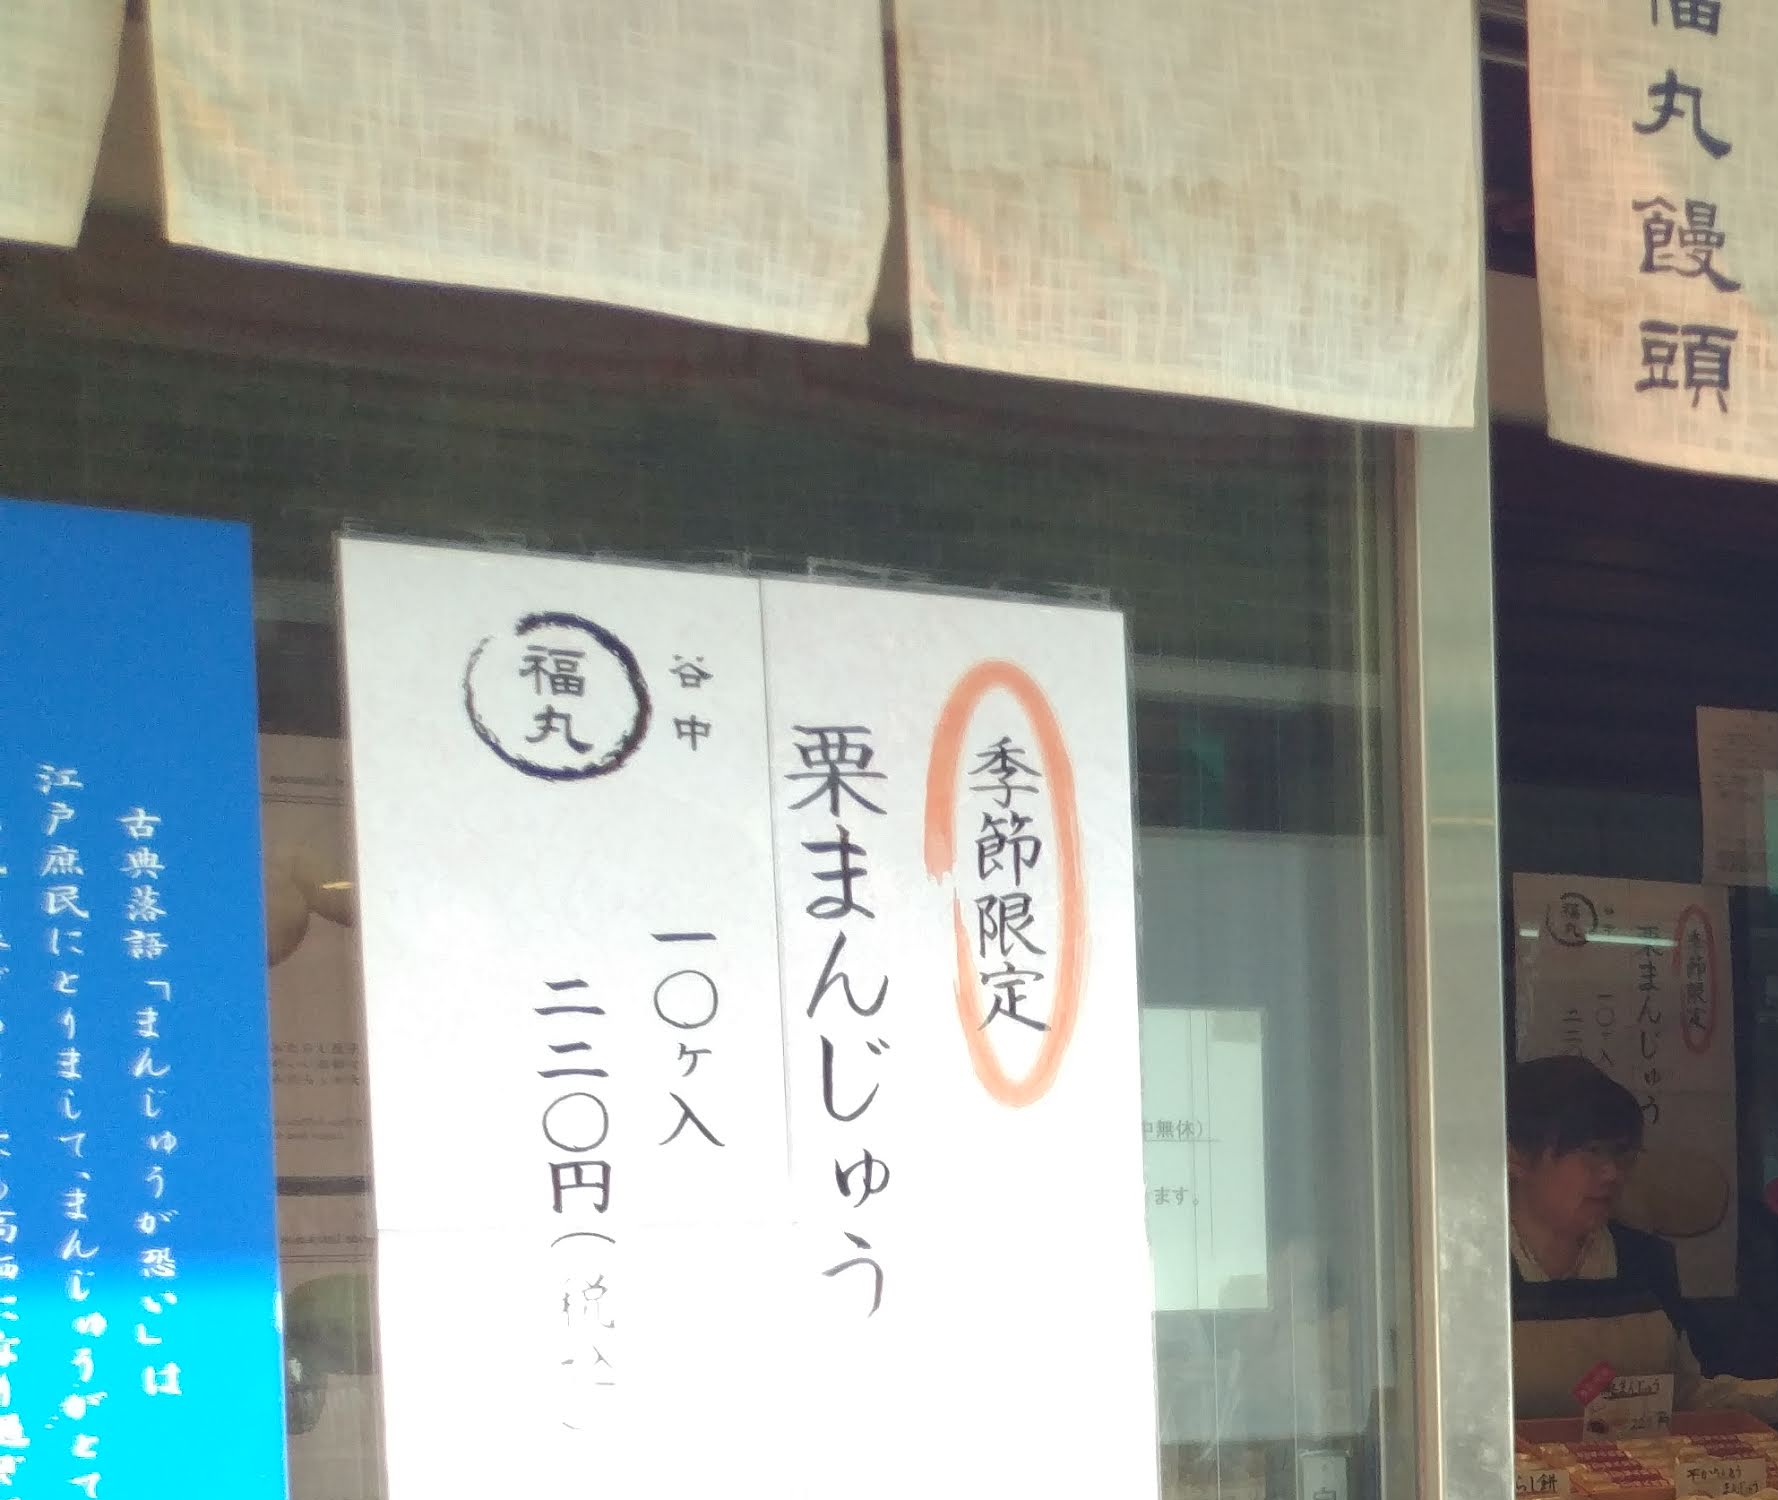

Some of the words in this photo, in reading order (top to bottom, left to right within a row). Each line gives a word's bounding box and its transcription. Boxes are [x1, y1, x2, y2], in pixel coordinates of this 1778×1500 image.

[518, 644, 595, 755] 福丸
[668, 653, 714, 753] 谷中
[968, 736, 1053, 1033] 季節限定
[782, 724, 891, 1319] 栗まんじゅう
